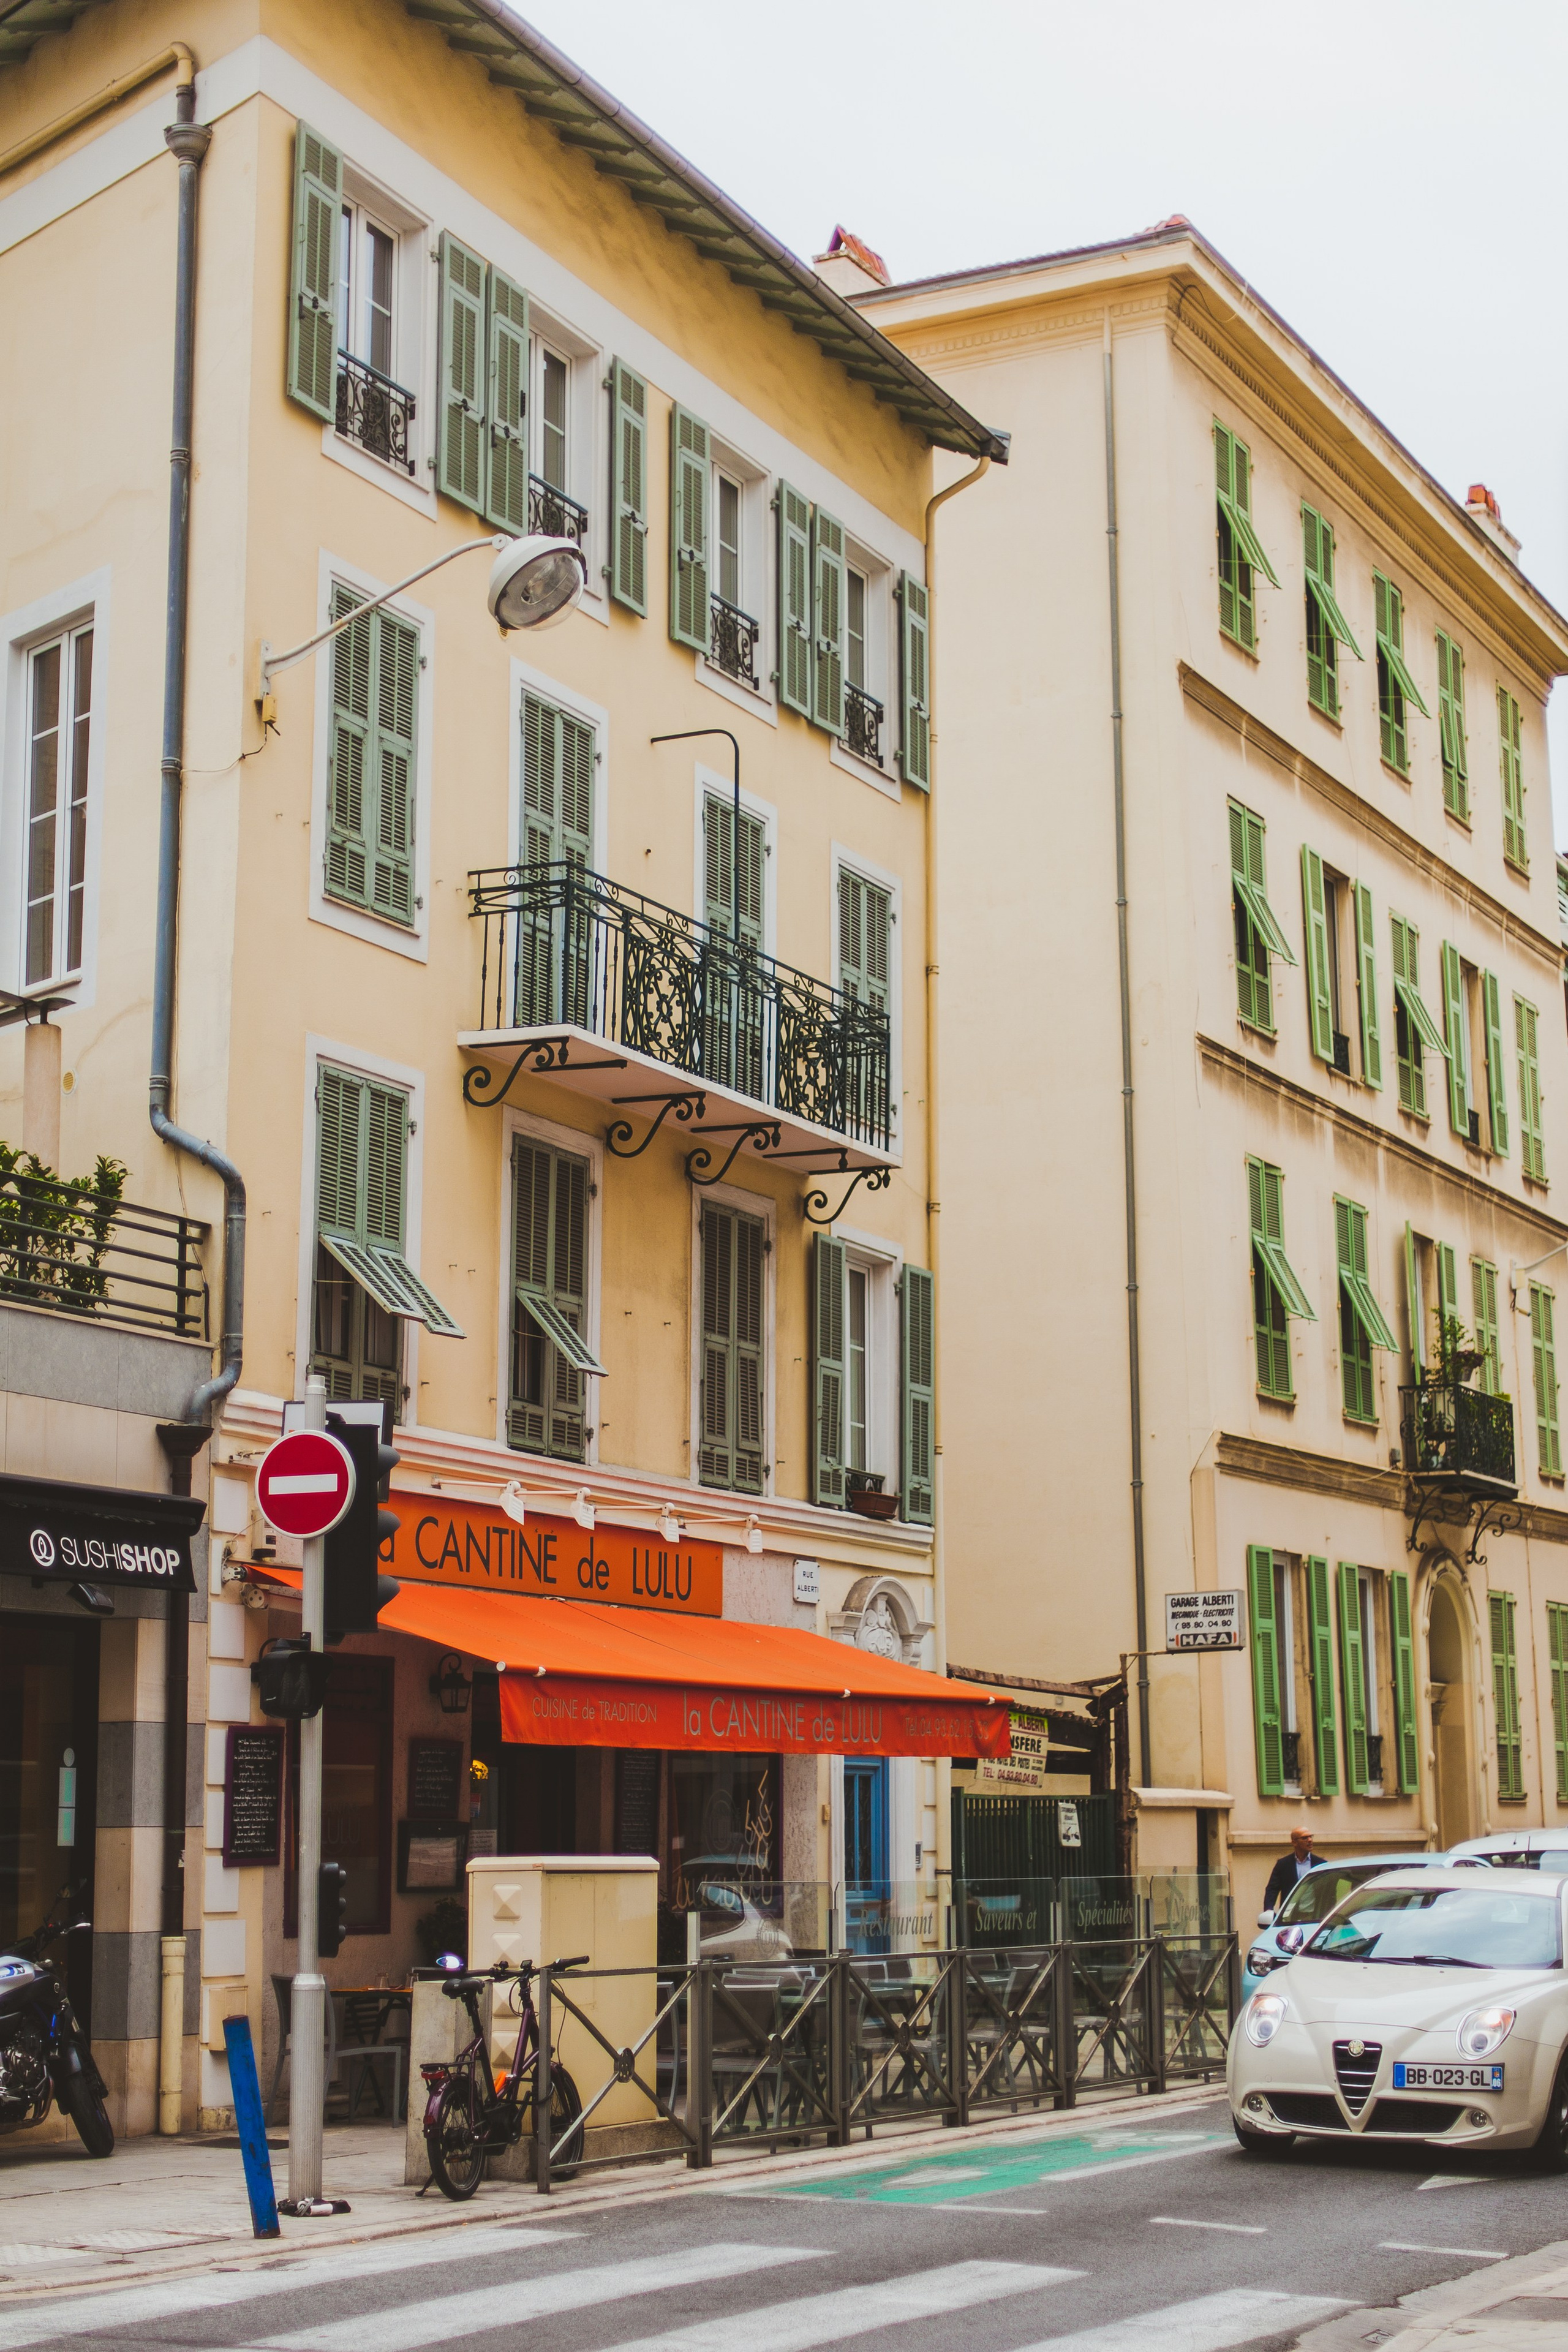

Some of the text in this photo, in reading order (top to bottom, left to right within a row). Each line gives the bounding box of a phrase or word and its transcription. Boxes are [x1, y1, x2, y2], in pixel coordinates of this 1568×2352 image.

[415, 1516, 557, 1584] CANTINE
[578, 1536, 609, 1590] de
[633, 1547, 692, 1601] LULU
[797, 1585, 819, 1593] ALBERTI
[1171, 1595, 1234, 1608] GARAGE ALBERTI
[1183, 1633, 1230, 1646] HAFA
[532, 1697, 578, 1720] CUISINE
[582, 1697, 595, 1720] de
[599, 1700, 657, 1723] TRADITION
[684, 1691, 701, 1735] la
[709, 1696, 805, 1742] CANTINE
[812, 1700, 835, 1742] de
[841, 1704, 883, 1744] LULU
[1019, 1715, 1045, 1733] ALBERTI
[1011, 1734, 1042, 1753] NSFÉRÉ
[859, 1909, 933, 1937] Restaurant
[975, 1905, 1038, 1932] Saveurs et
[1077, 1899, 1134, 1934] Spécialités
[1407, 2068, 1502, 2087] BB-023-GL 06
